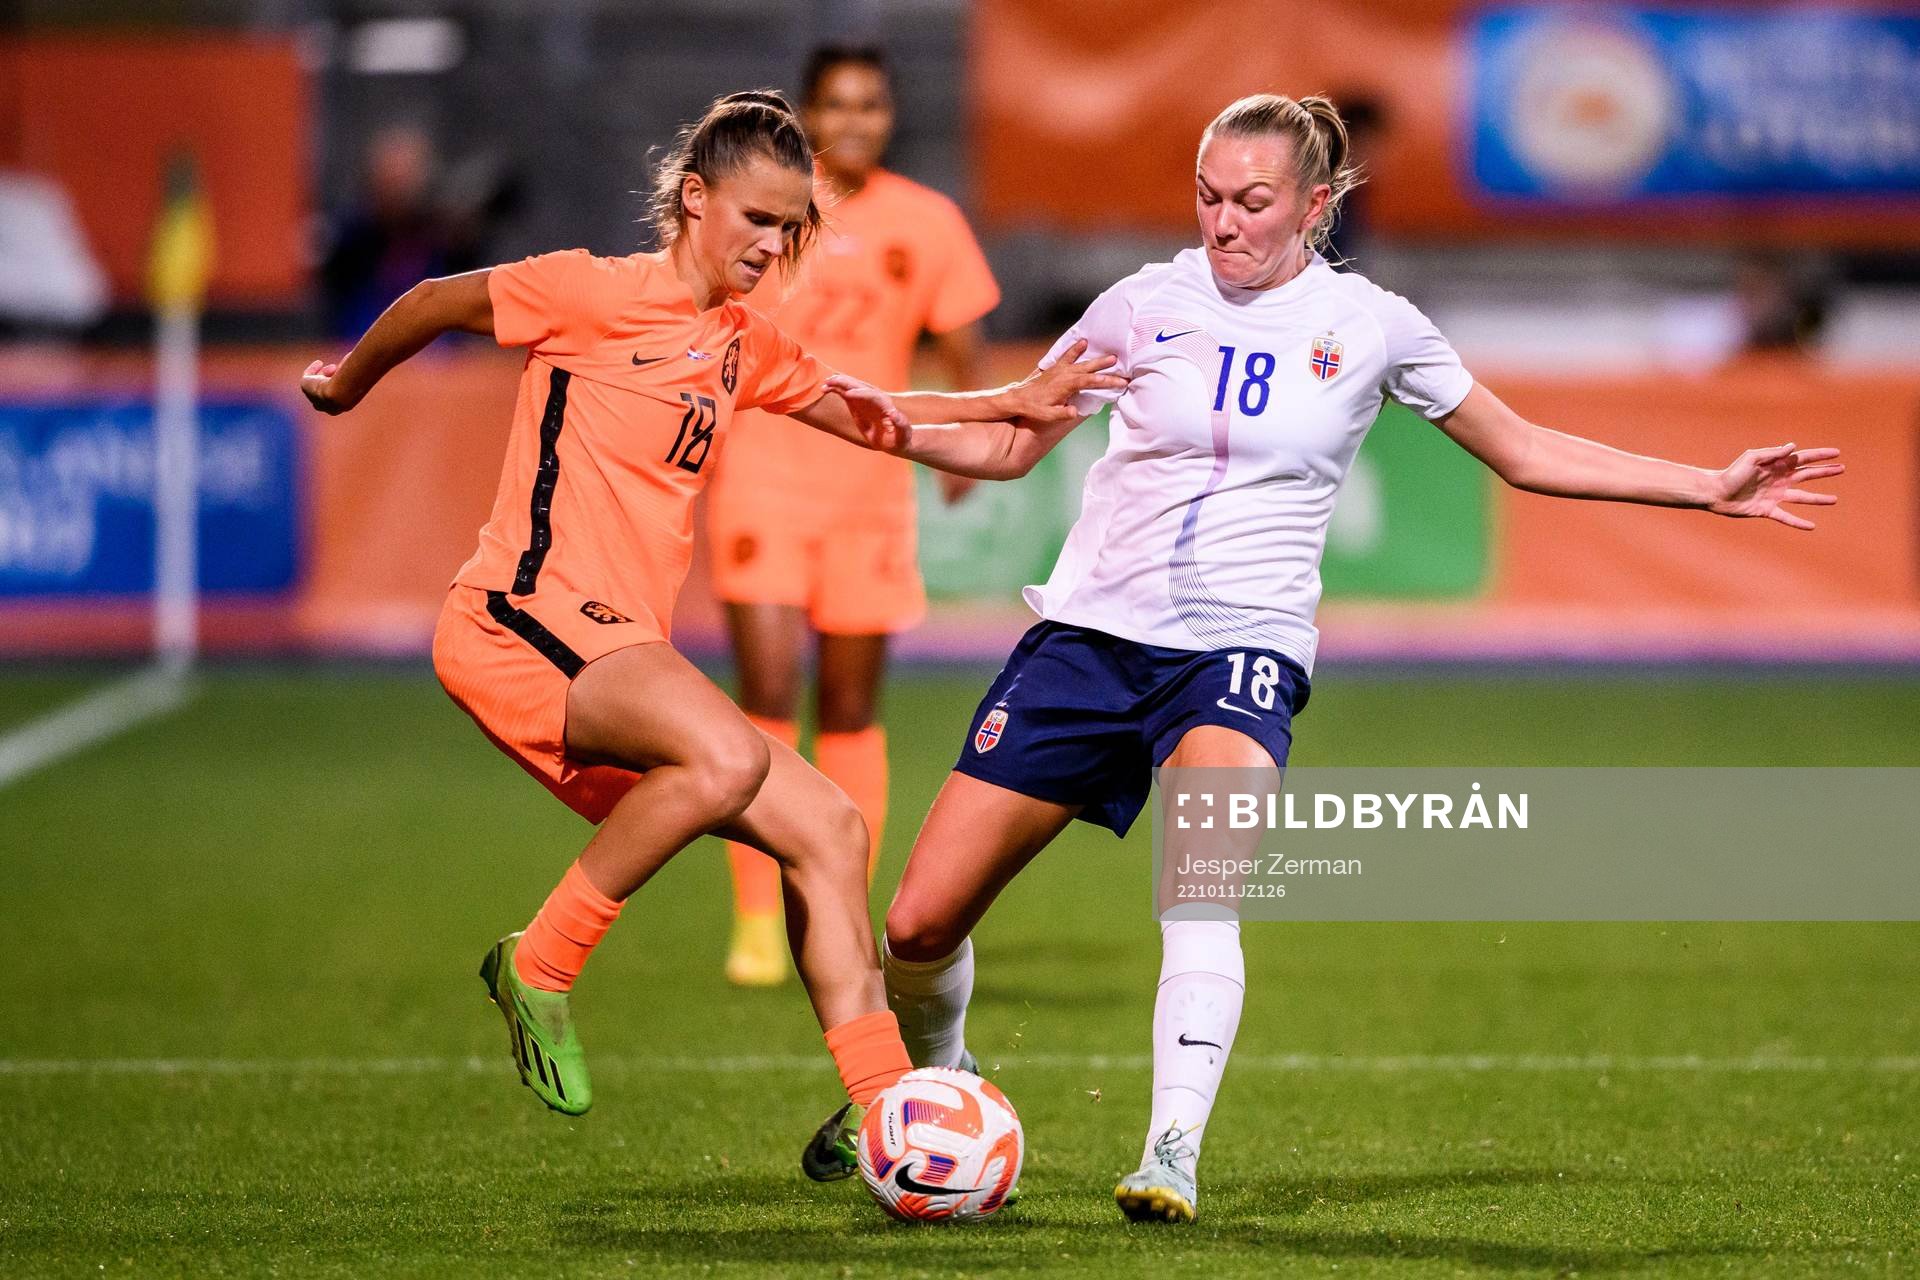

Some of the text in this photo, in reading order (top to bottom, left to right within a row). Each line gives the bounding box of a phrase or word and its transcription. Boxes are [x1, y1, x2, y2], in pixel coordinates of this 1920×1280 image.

[1213, 345, 1276, 417] 18
[664, 392, 717, 474] 18
[1227, 652, 1280, 710] 18
